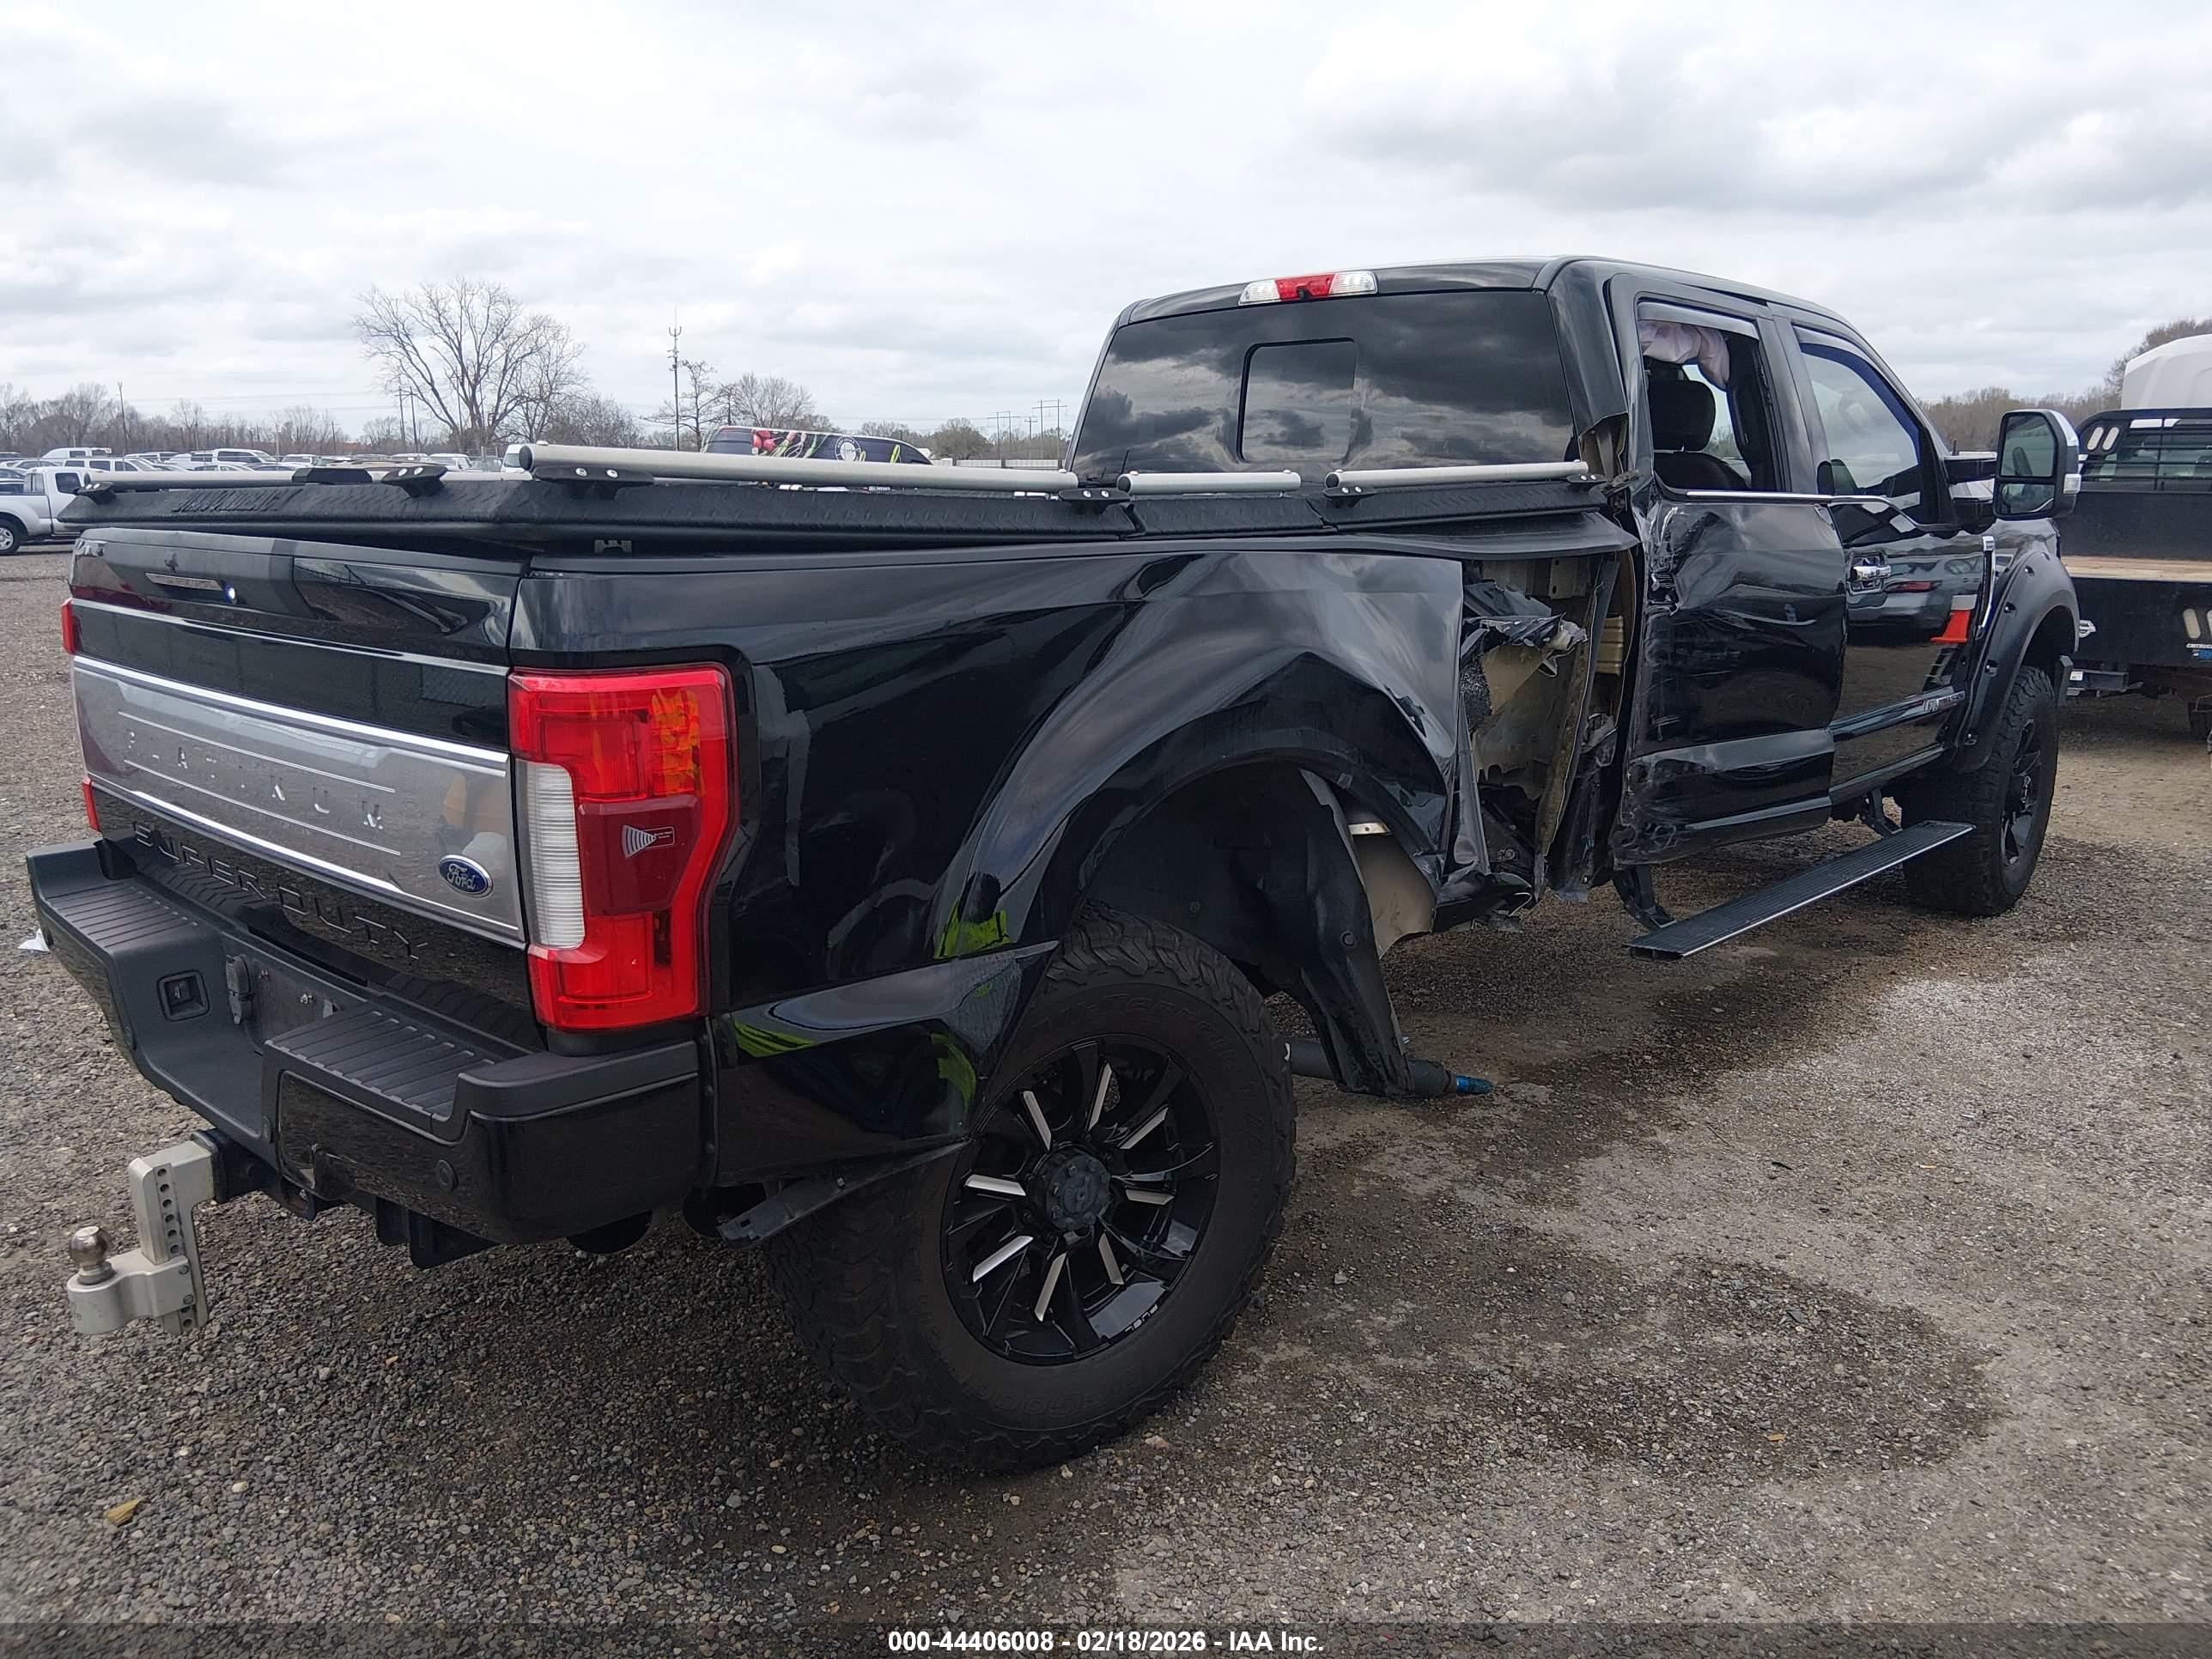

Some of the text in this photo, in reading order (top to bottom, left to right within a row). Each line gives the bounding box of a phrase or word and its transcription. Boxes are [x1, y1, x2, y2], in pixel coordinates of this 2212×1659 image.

[447, 862, 476, 890] Ford
[276, 883, 429, 961] DUTY
[1124, 1304, 1158, 1332] FUEL
